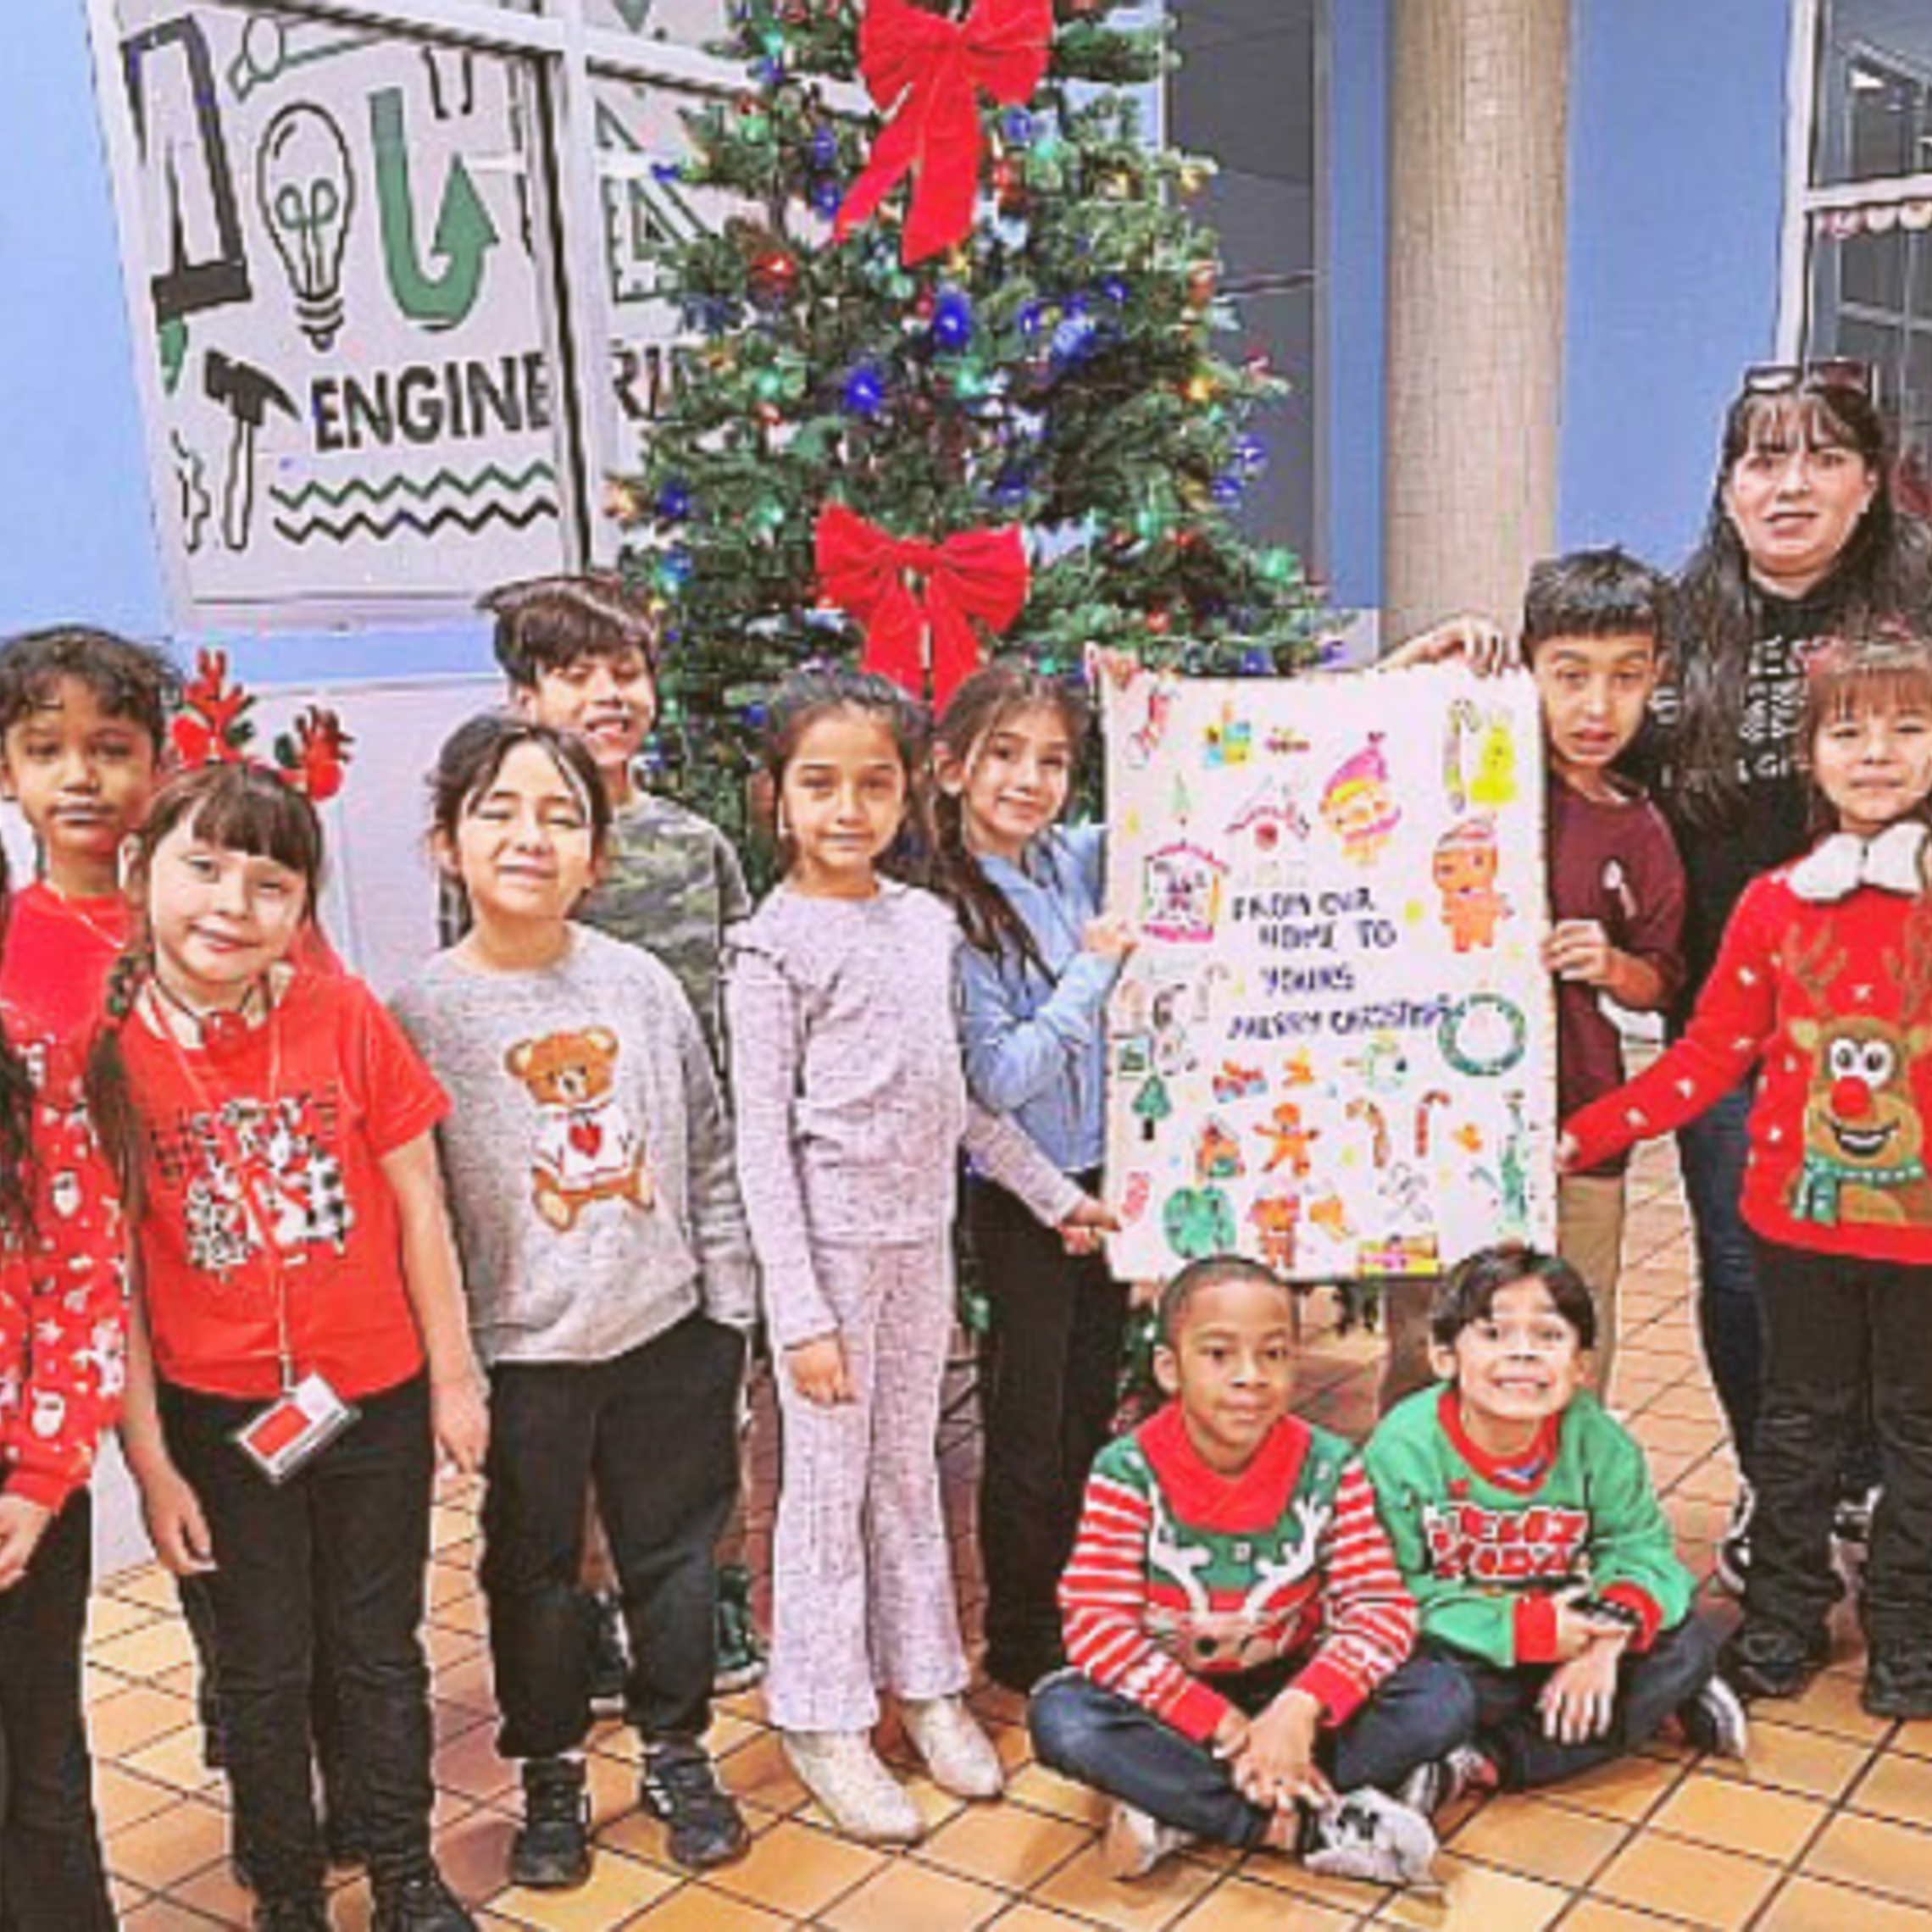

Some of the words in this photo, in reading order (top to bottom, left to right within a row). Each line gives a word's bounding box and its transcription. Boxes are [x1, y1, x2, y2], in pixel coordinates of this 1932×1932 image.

[311, 352, 552, 452] ENGINE
[1231, 892, 1312, 921] FROM
[1319, 887, 1375, 916] OUR
[1258, 923, 1335, 949] HOME
[1356, 919, 1398, 949] TO
[1259, 963, 1355, 995] YOURS
[1227, 1011, 1322, 1040] MERRY
